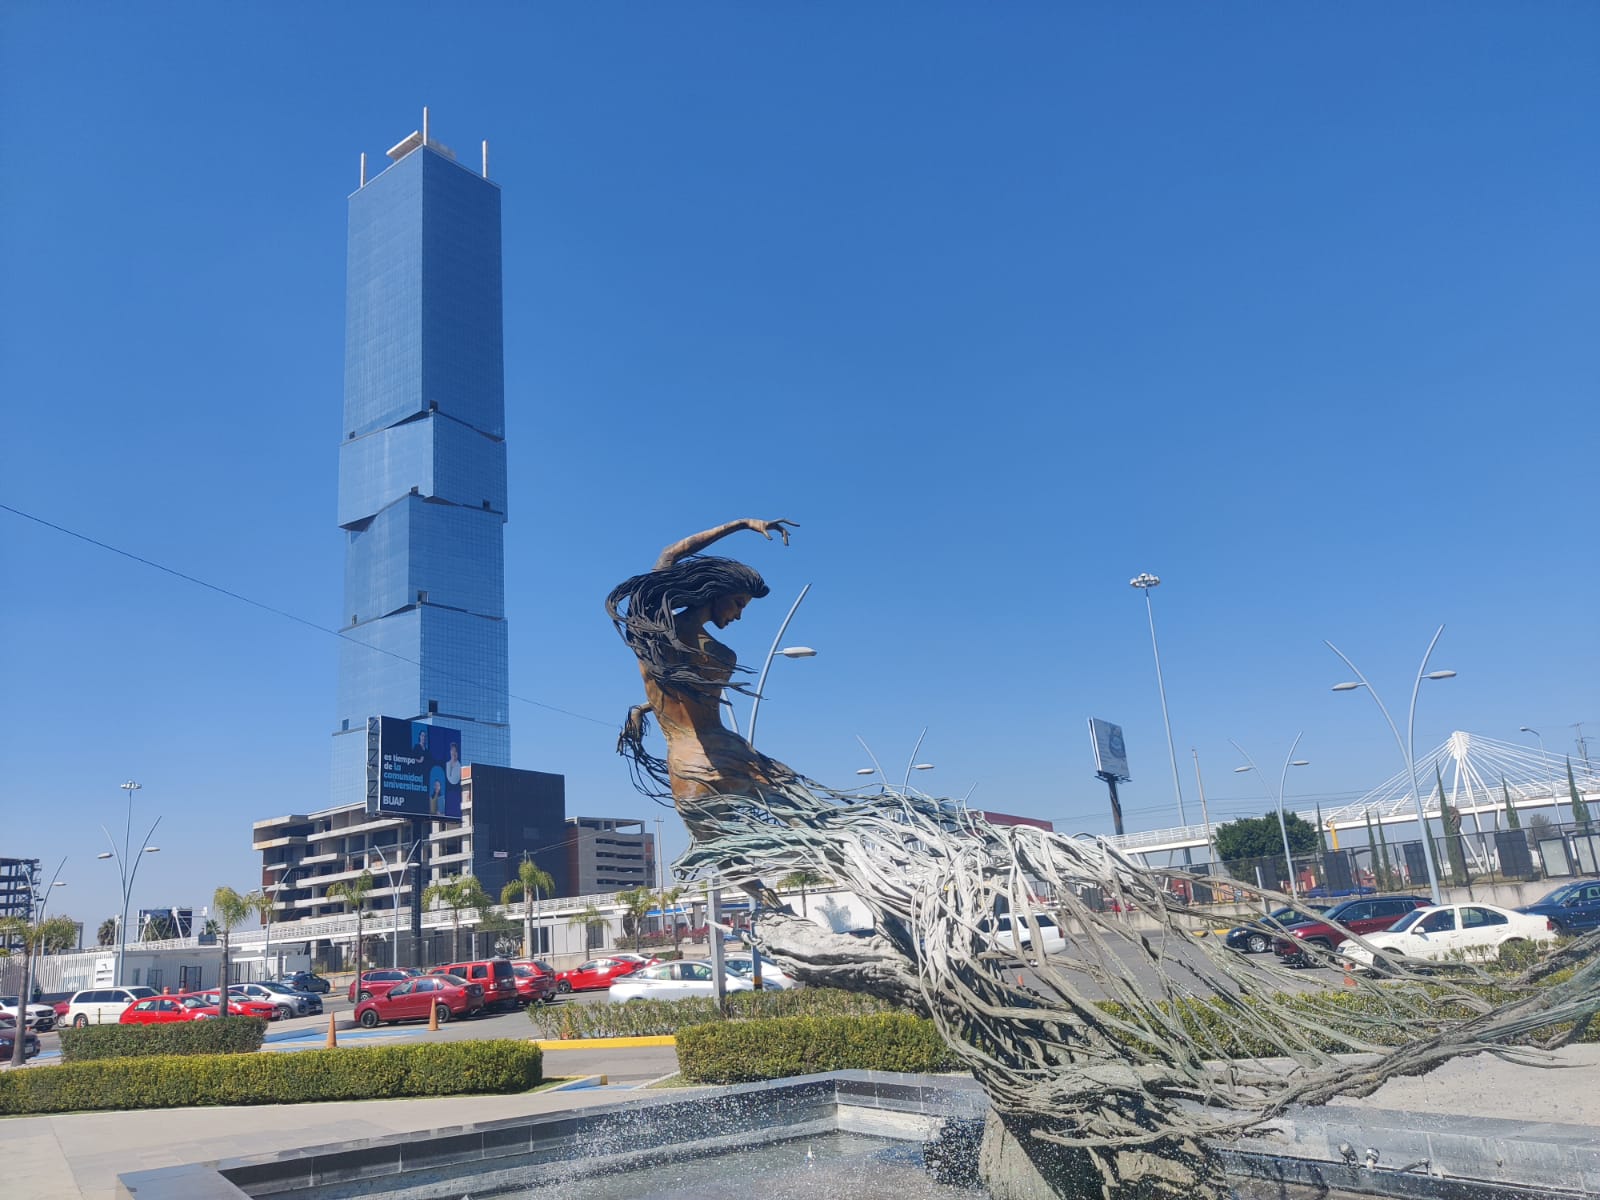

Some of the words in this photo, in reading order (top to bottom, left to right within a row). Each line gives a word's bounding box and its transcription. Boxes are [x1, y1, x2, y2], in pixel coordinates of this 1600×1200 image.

[393, 753, 416, 765] tiempo
[384, 762, 392, 770] de
[383, 772, 424, 783] comunidad
[383, 796, 405, 806] BUAP
